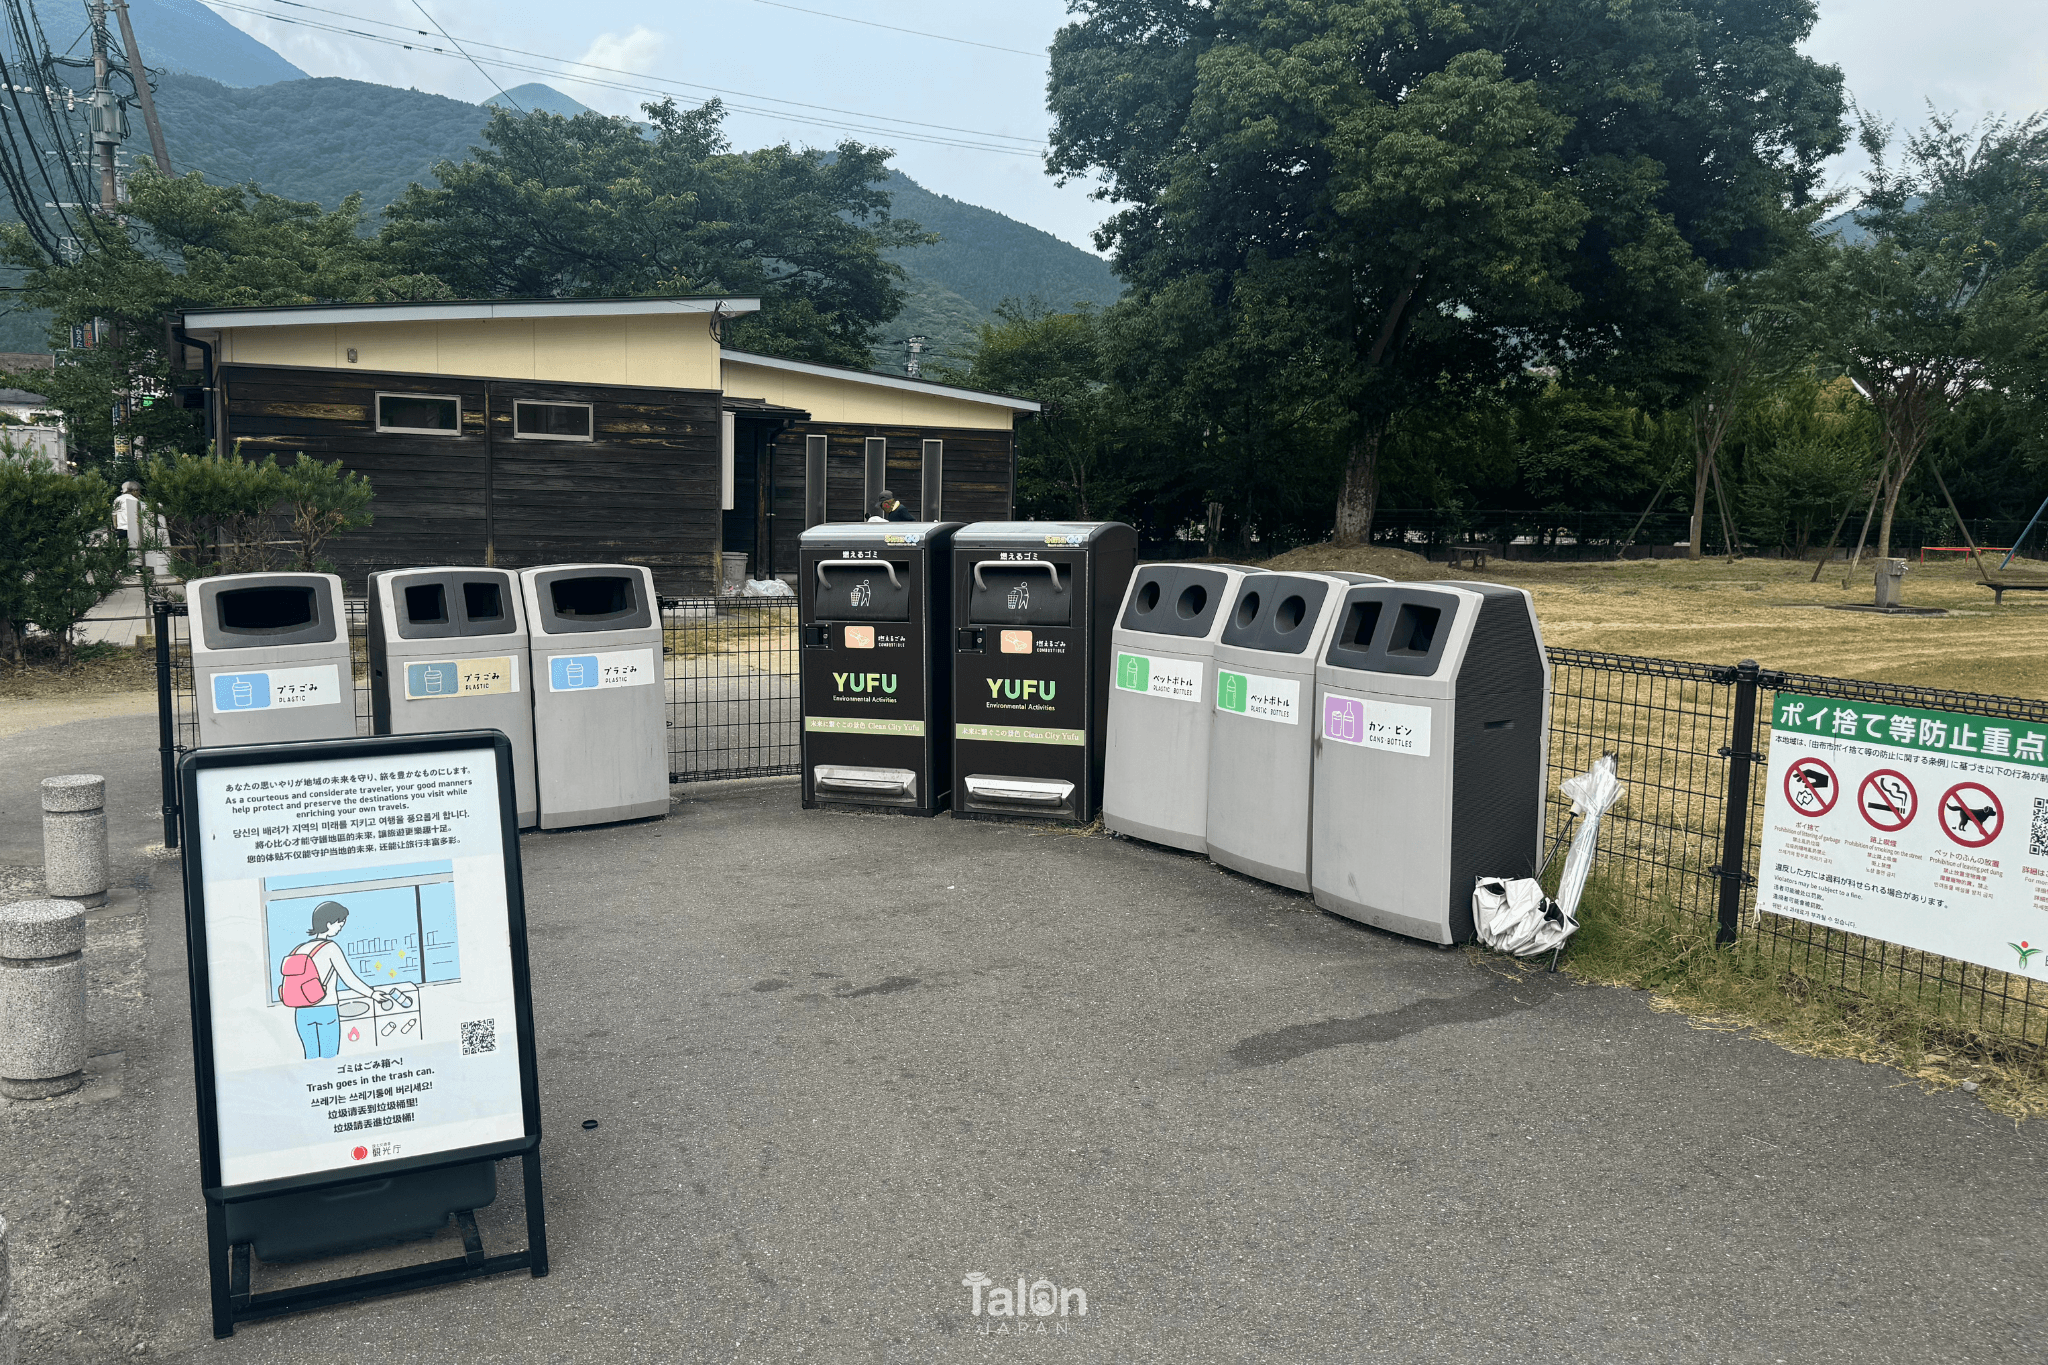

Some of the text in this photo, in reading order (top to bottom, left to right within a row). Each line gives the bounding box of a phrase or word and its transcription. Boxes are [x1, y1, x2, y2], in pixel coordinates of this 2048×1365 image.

[832, 672, 897, 694] YUFU
[986, 678, 1056, 700] YUFU
[1153, 674, 1193, 687] ペットボトル
[278, 695, 306, 703] PLASTIC
[833, 694, 897, 704] Environmental Activities
[1153, 685, 1193, 696] PLASTIC BOTTLES
[986, 701, 1055, 711] Environmental Activities
[1251, 695, 1290, 707] ペットボトル
[1251, 705, 1290, 718] PLASTIC BOTTLES
[868, 722, 887, 730] Clean
[888, 723, 902, 732] City
[1023, 730, 1043, 739] Clean
[1045, 731, 1060, 741] City
[1061, 732, 1079, 741] Yufu
[1780, 702, 2047, 762] ポイ捨て等防止重点
[247, 794, 289, 802] courteous
[292, 791, 307, 799] and
[309, 788, 357, 798] considerate
[359, 785, 394, 794] traveler,
[396, 784, 414, 792] your
[417, 781, 436, 791] good
[438, 780, 472, 789] manners
[232, 806, 250, 814] help
[253, 803, 284, 814] protect
[286, 801, 301, 809] and
[304, 800, 341, 810] preserve
[359, 794, 408, 803] destinations
[411, 793, 425, 801] you
[446, 788, 467, 796] while
[296, 809, 335, 818] enriching
[337, 808, 356, 816] your
[378, 803, 409, 811] travels.
[233, 809, 469, 838] 당신의 배려가 지역의 미래를 지키고 여행을 풍요롭게 합니다.
[1796, 822, 1820, 832] ポイ捨て
[1774, 825, 1796, 835] Prohibition
[1802, 830, 1818, 840] littering
[1823, 836, 1841, 845] garbage
[1844, 839, 1869, 849] Prohibition
[1874, 846, 1893, 856] smoking
[1929, 856, 1956, 867] Prohibition
[1962, 863, 1980, 873] leaving
[1990, 869, 2003, 878] dung
[1774, 875, 1797, 885] Violators
[1798, 880, 1809, 888] may
[1811, 882, 1817, 890] be
[1818, 884, 1838, 896] subject
[1850, 892, 1863, 900] fine.
[306, 1068, 435, 1092] Trash goes in the trash can.
[311, 1081, 432, 1107] 쓰레기는 쓰레기통에 버리세요!
